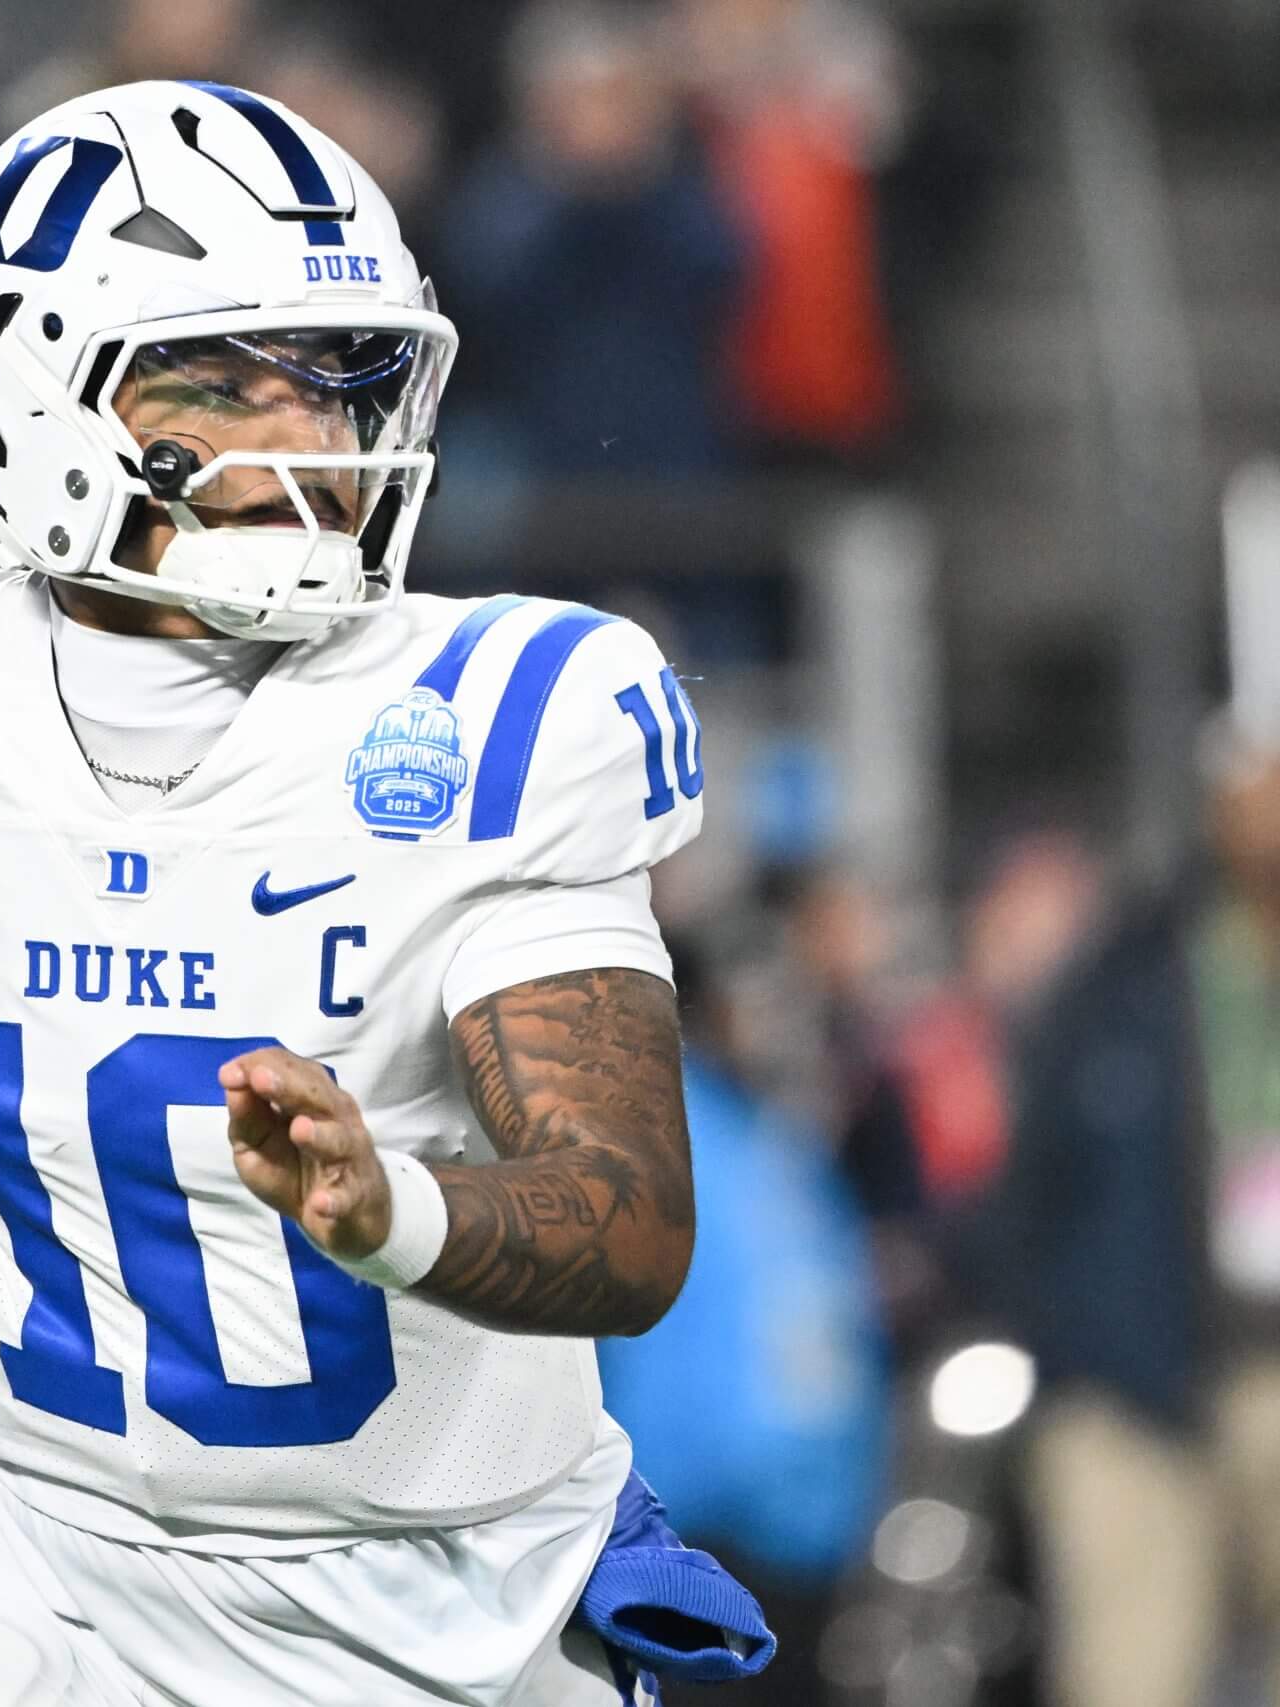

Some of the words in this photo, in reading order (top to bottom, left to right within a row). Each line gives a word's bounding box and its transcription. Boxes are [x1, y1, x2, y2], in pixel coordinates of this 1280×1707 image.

[303, 255, 382, 283] DUKE
[347, 743, 466, 790] CHAMPIONSHIP
[615, 667, 704, 820] 10
[385, 798, 421, 813] 2025
[108, 851, 148, 894] D
[24, 940, 216, 1010] DUKE
[320, 926, 366, 1018] C
